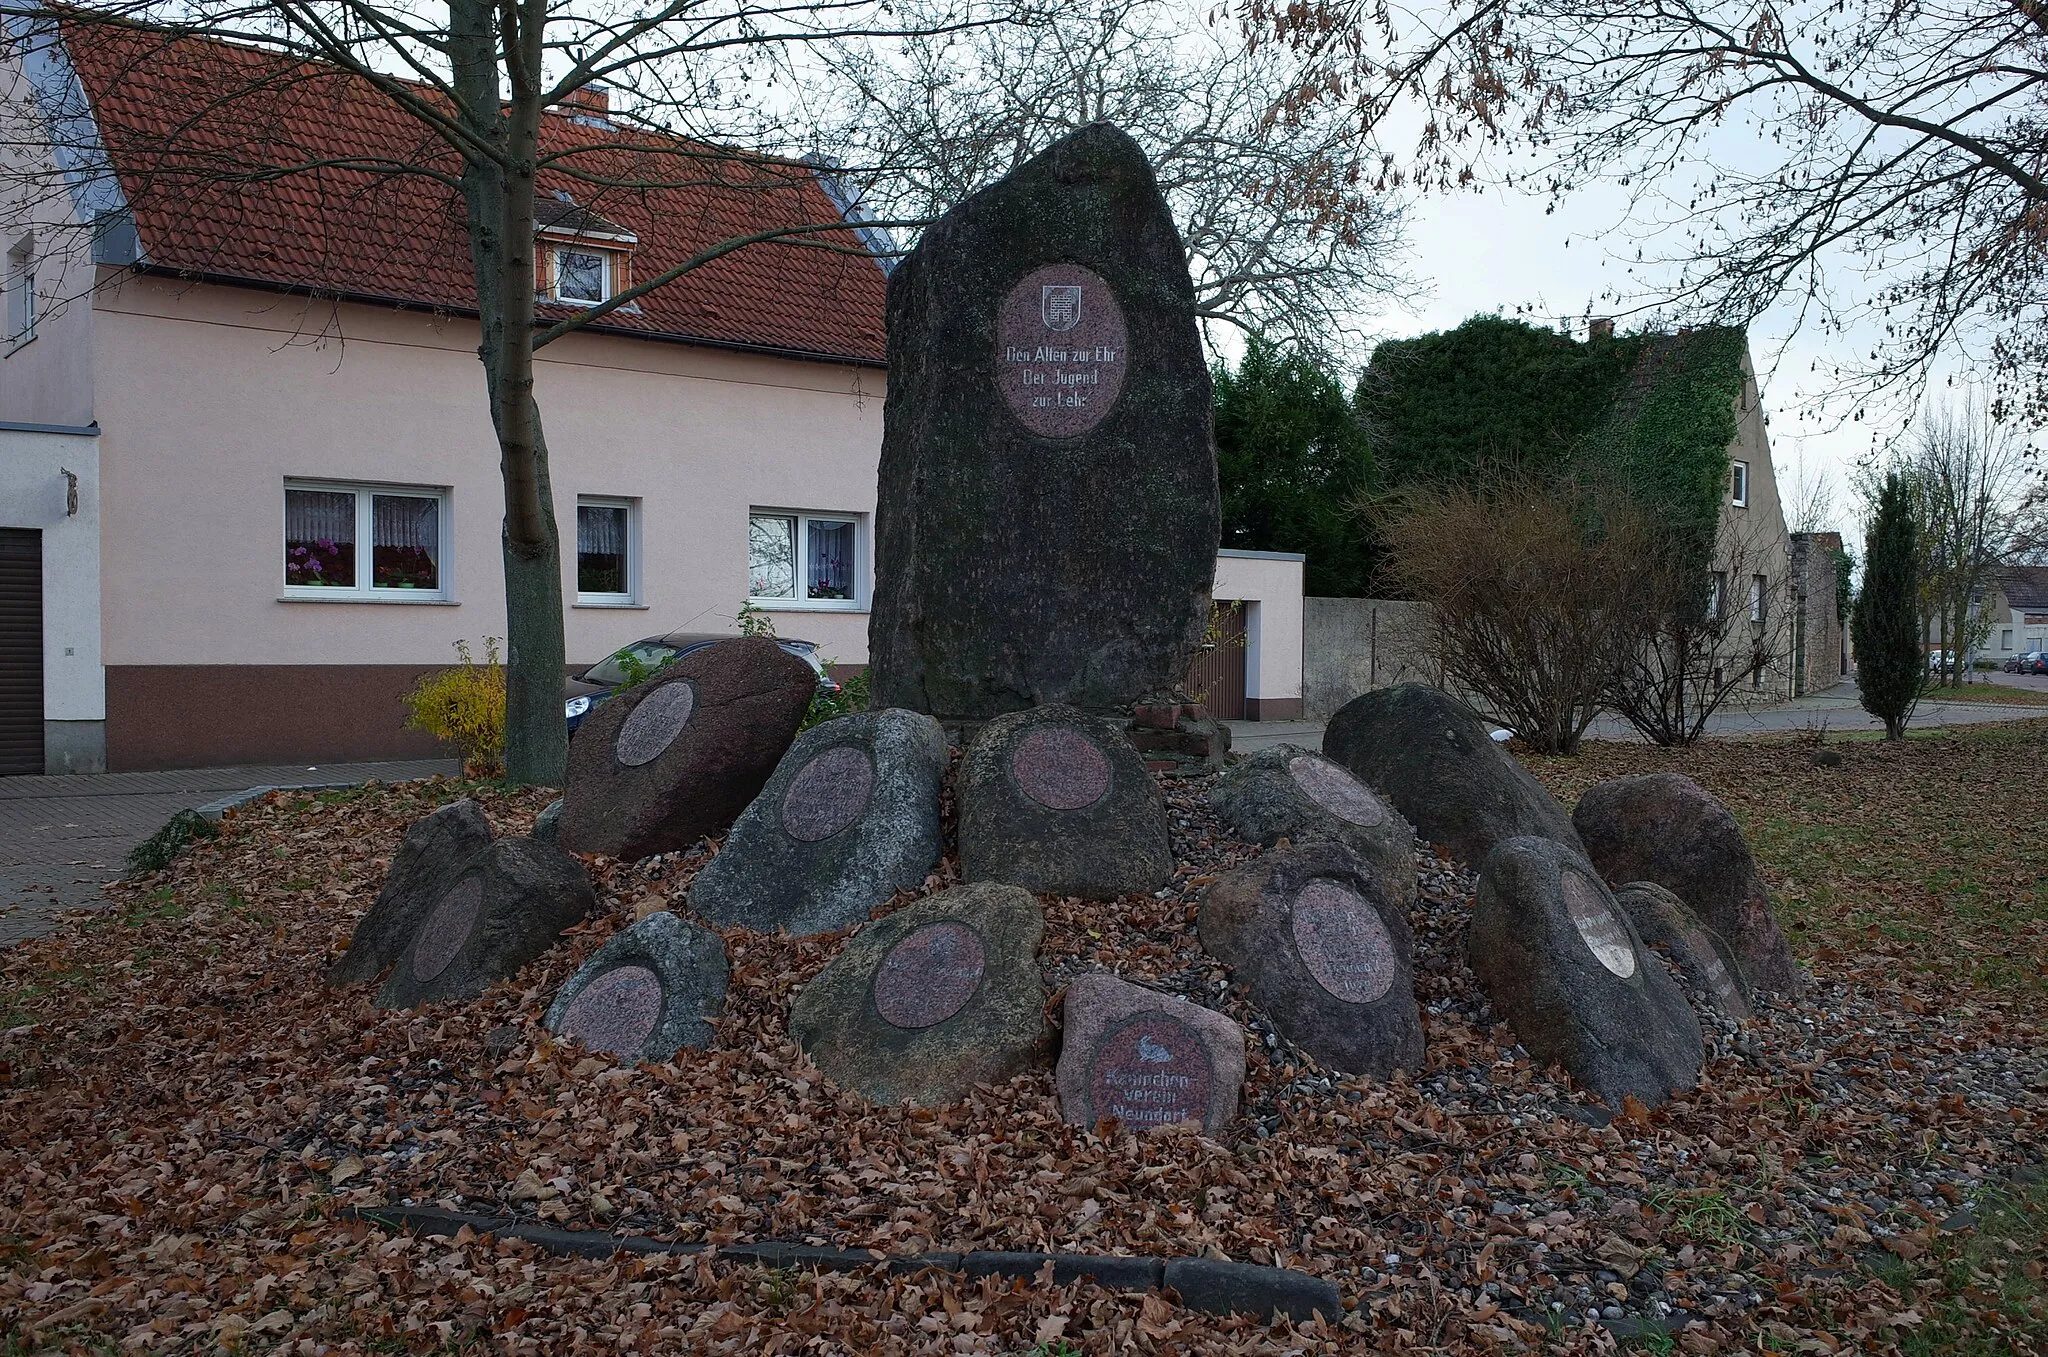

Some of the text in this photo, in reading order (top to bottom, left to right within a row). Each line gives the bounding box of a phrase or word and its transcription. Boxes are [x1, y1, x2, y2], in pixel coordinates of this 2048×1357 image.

[1006, 346, 1030, 362] Den
[1034, 346, 1067, 362] Alten
[1072, 350, 1091, 362] zur
[1023, 369, 1098, 388] Der Jugend
[1033, 396, 1051, 407] zur
[1123, 1088, 1177, 1103] verein
[1112, 1105, 1188, 1122] Neundorf
